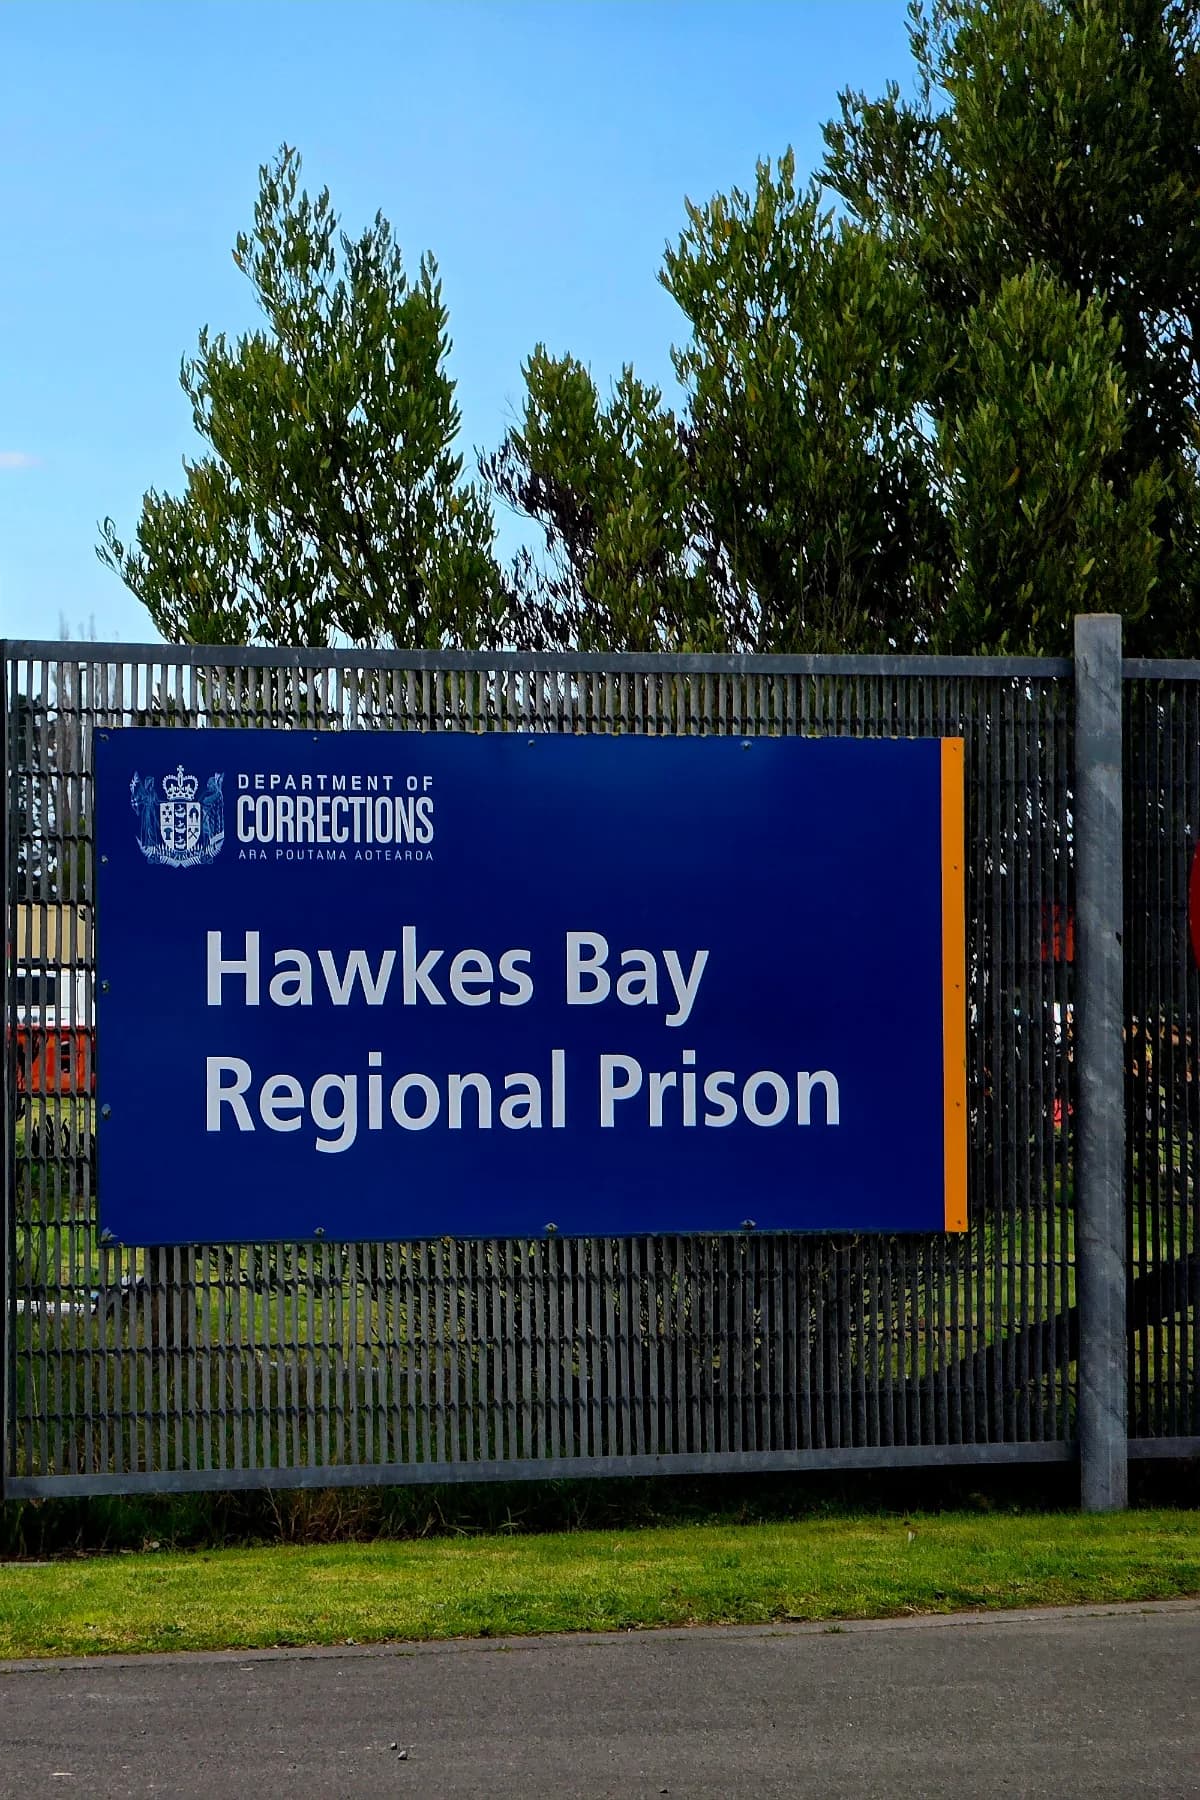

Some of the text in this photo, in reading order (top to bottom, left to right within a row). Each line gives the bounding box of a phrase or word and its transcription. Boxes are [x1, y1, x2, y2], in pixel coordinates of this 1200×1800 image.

[238, 773, 433, 792] DEPARTMENT OF
[237, 794, 434, 844] CORRECTIONS
[238, 849, 434, 861] ARA POUTAMA AOTEAROA
[207, 925, 710, 1027] Hawkes Bay
[206, 1049, 840, 1154] Regional Prison
